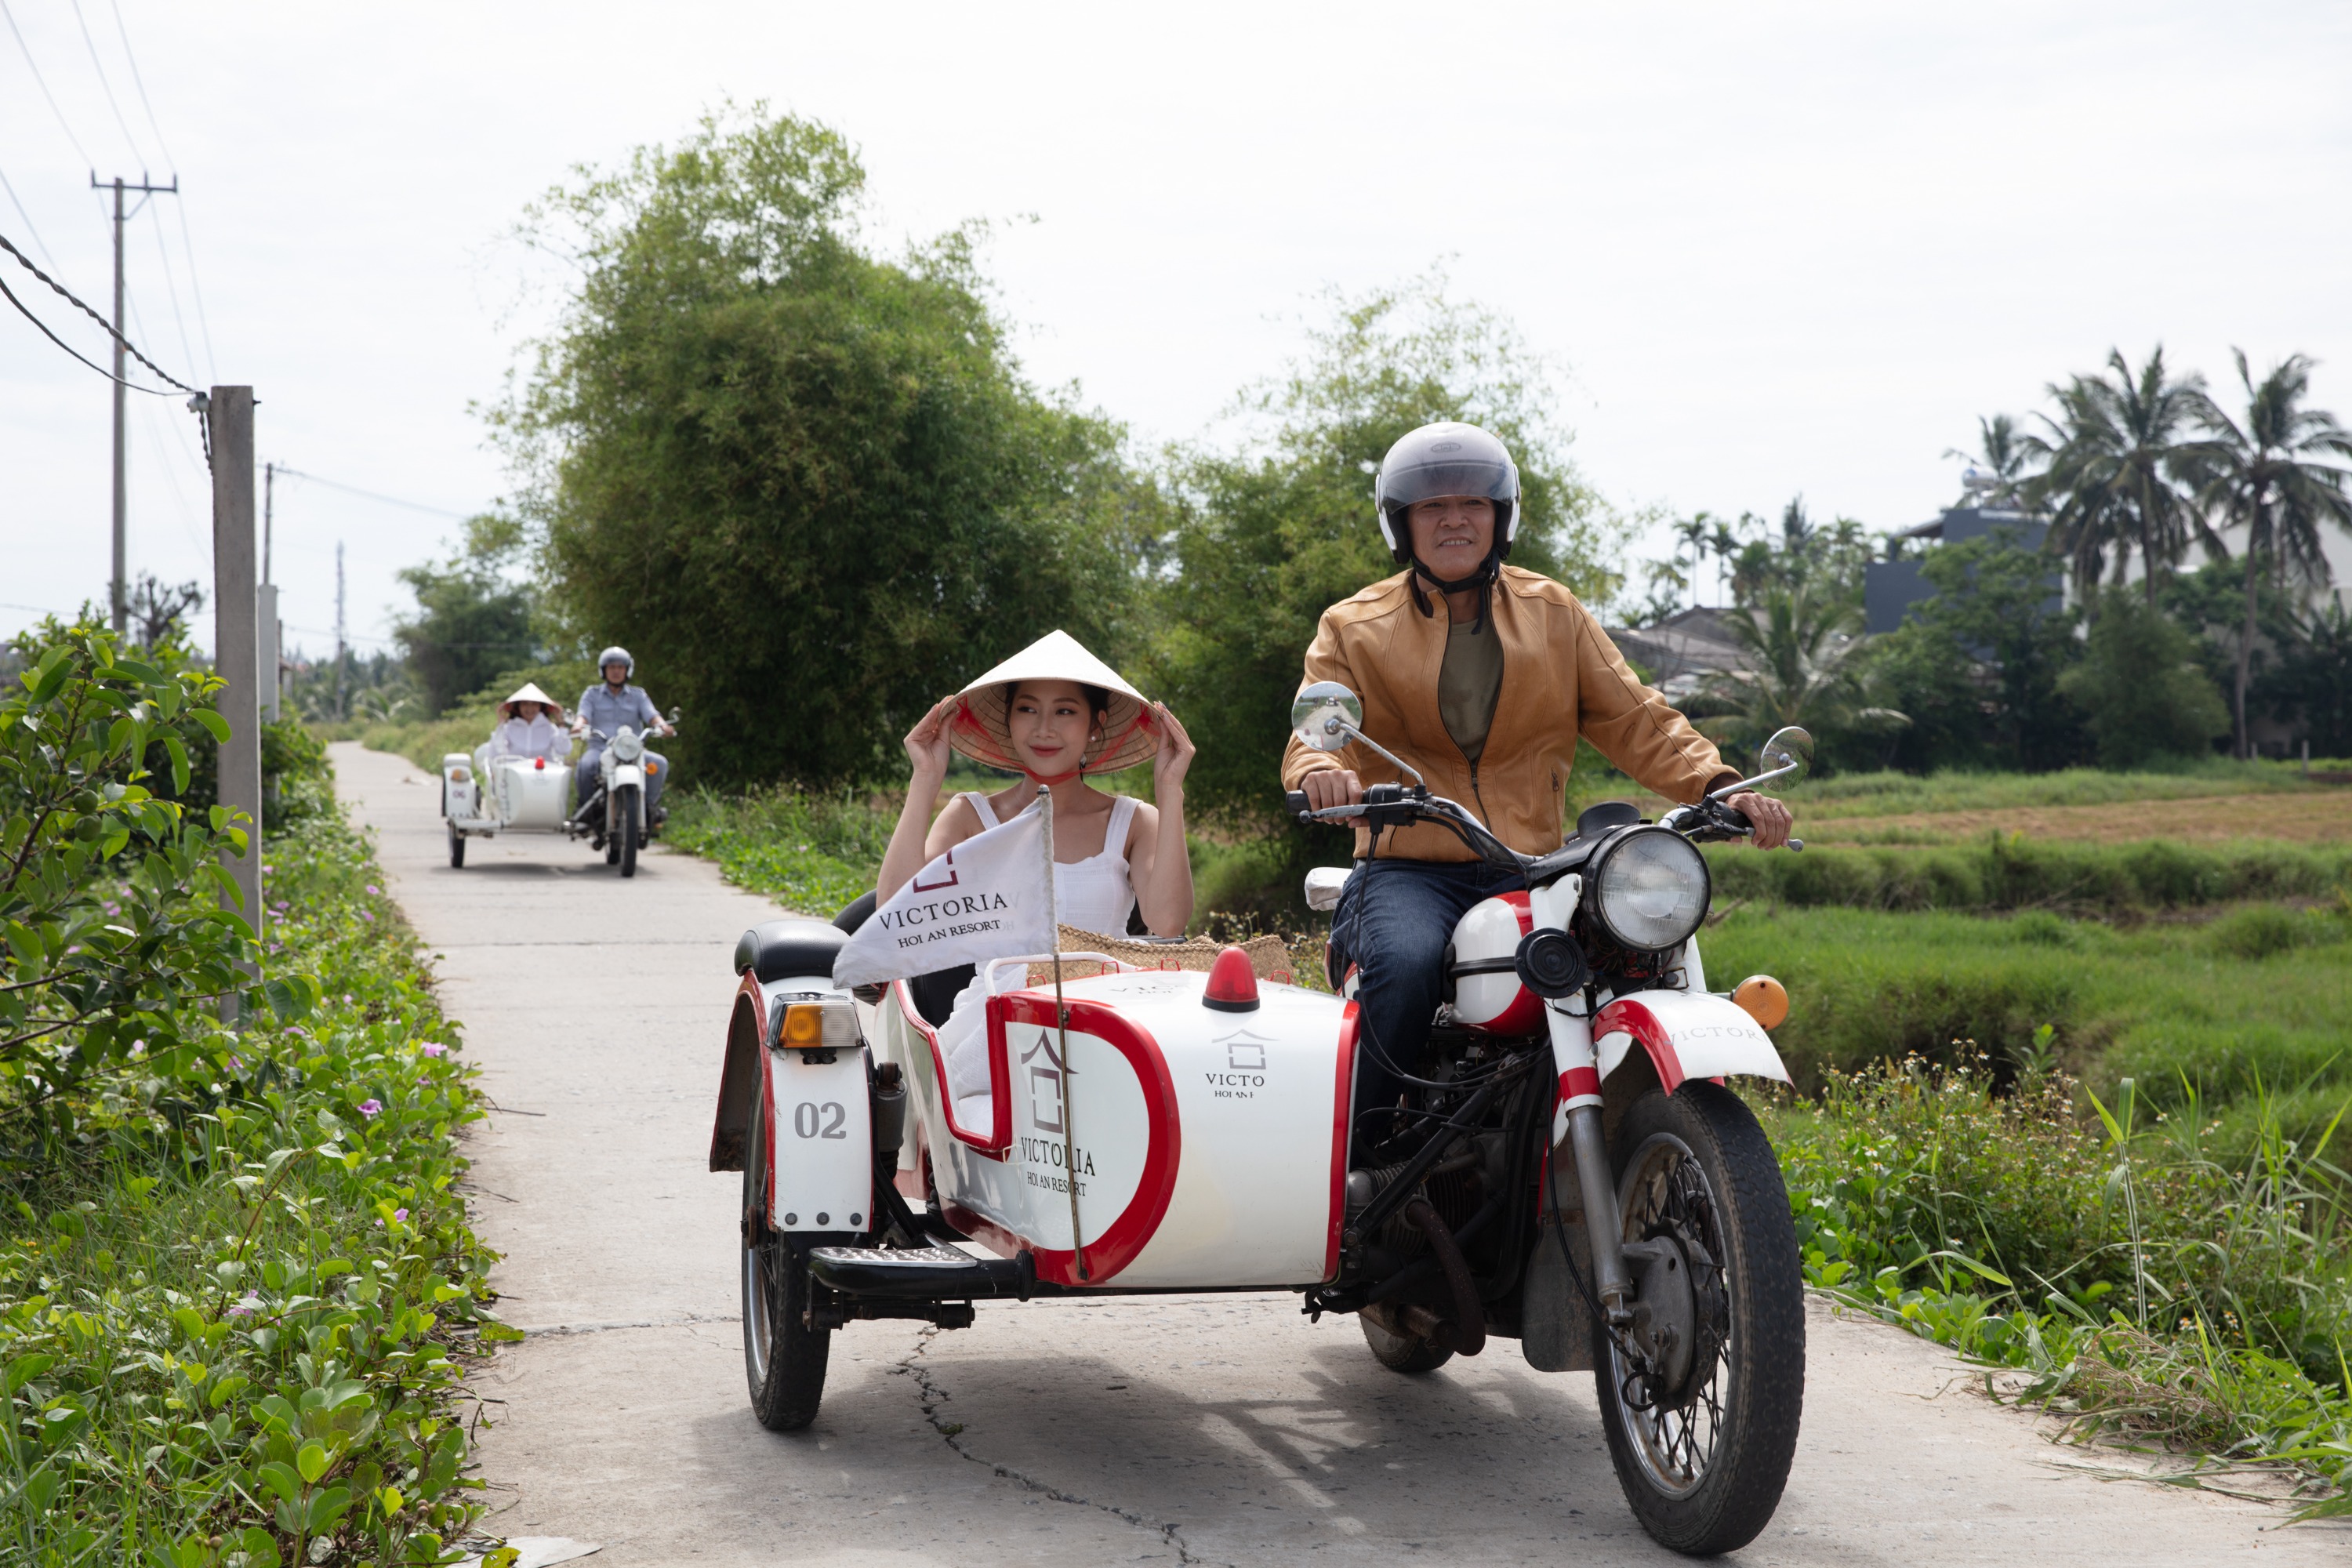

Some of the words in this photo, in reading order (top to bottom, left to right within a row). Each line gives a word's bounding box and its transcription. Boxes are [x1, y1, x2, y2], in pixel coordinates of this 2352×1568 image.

[879, 892, 1008, 931] VICTORIA
[898, 935, 924, 948] HOI
[927, 929, 947, 942] AN
[949, 920, 1001, 937] RESORT
[1206, 1073, 1265, 1087] VICTO
[794, 1102, 847, 1140] 02
[1027, 1171, 1039, 1187] HOI
[1040, 1175, 1051, 1190] AN
